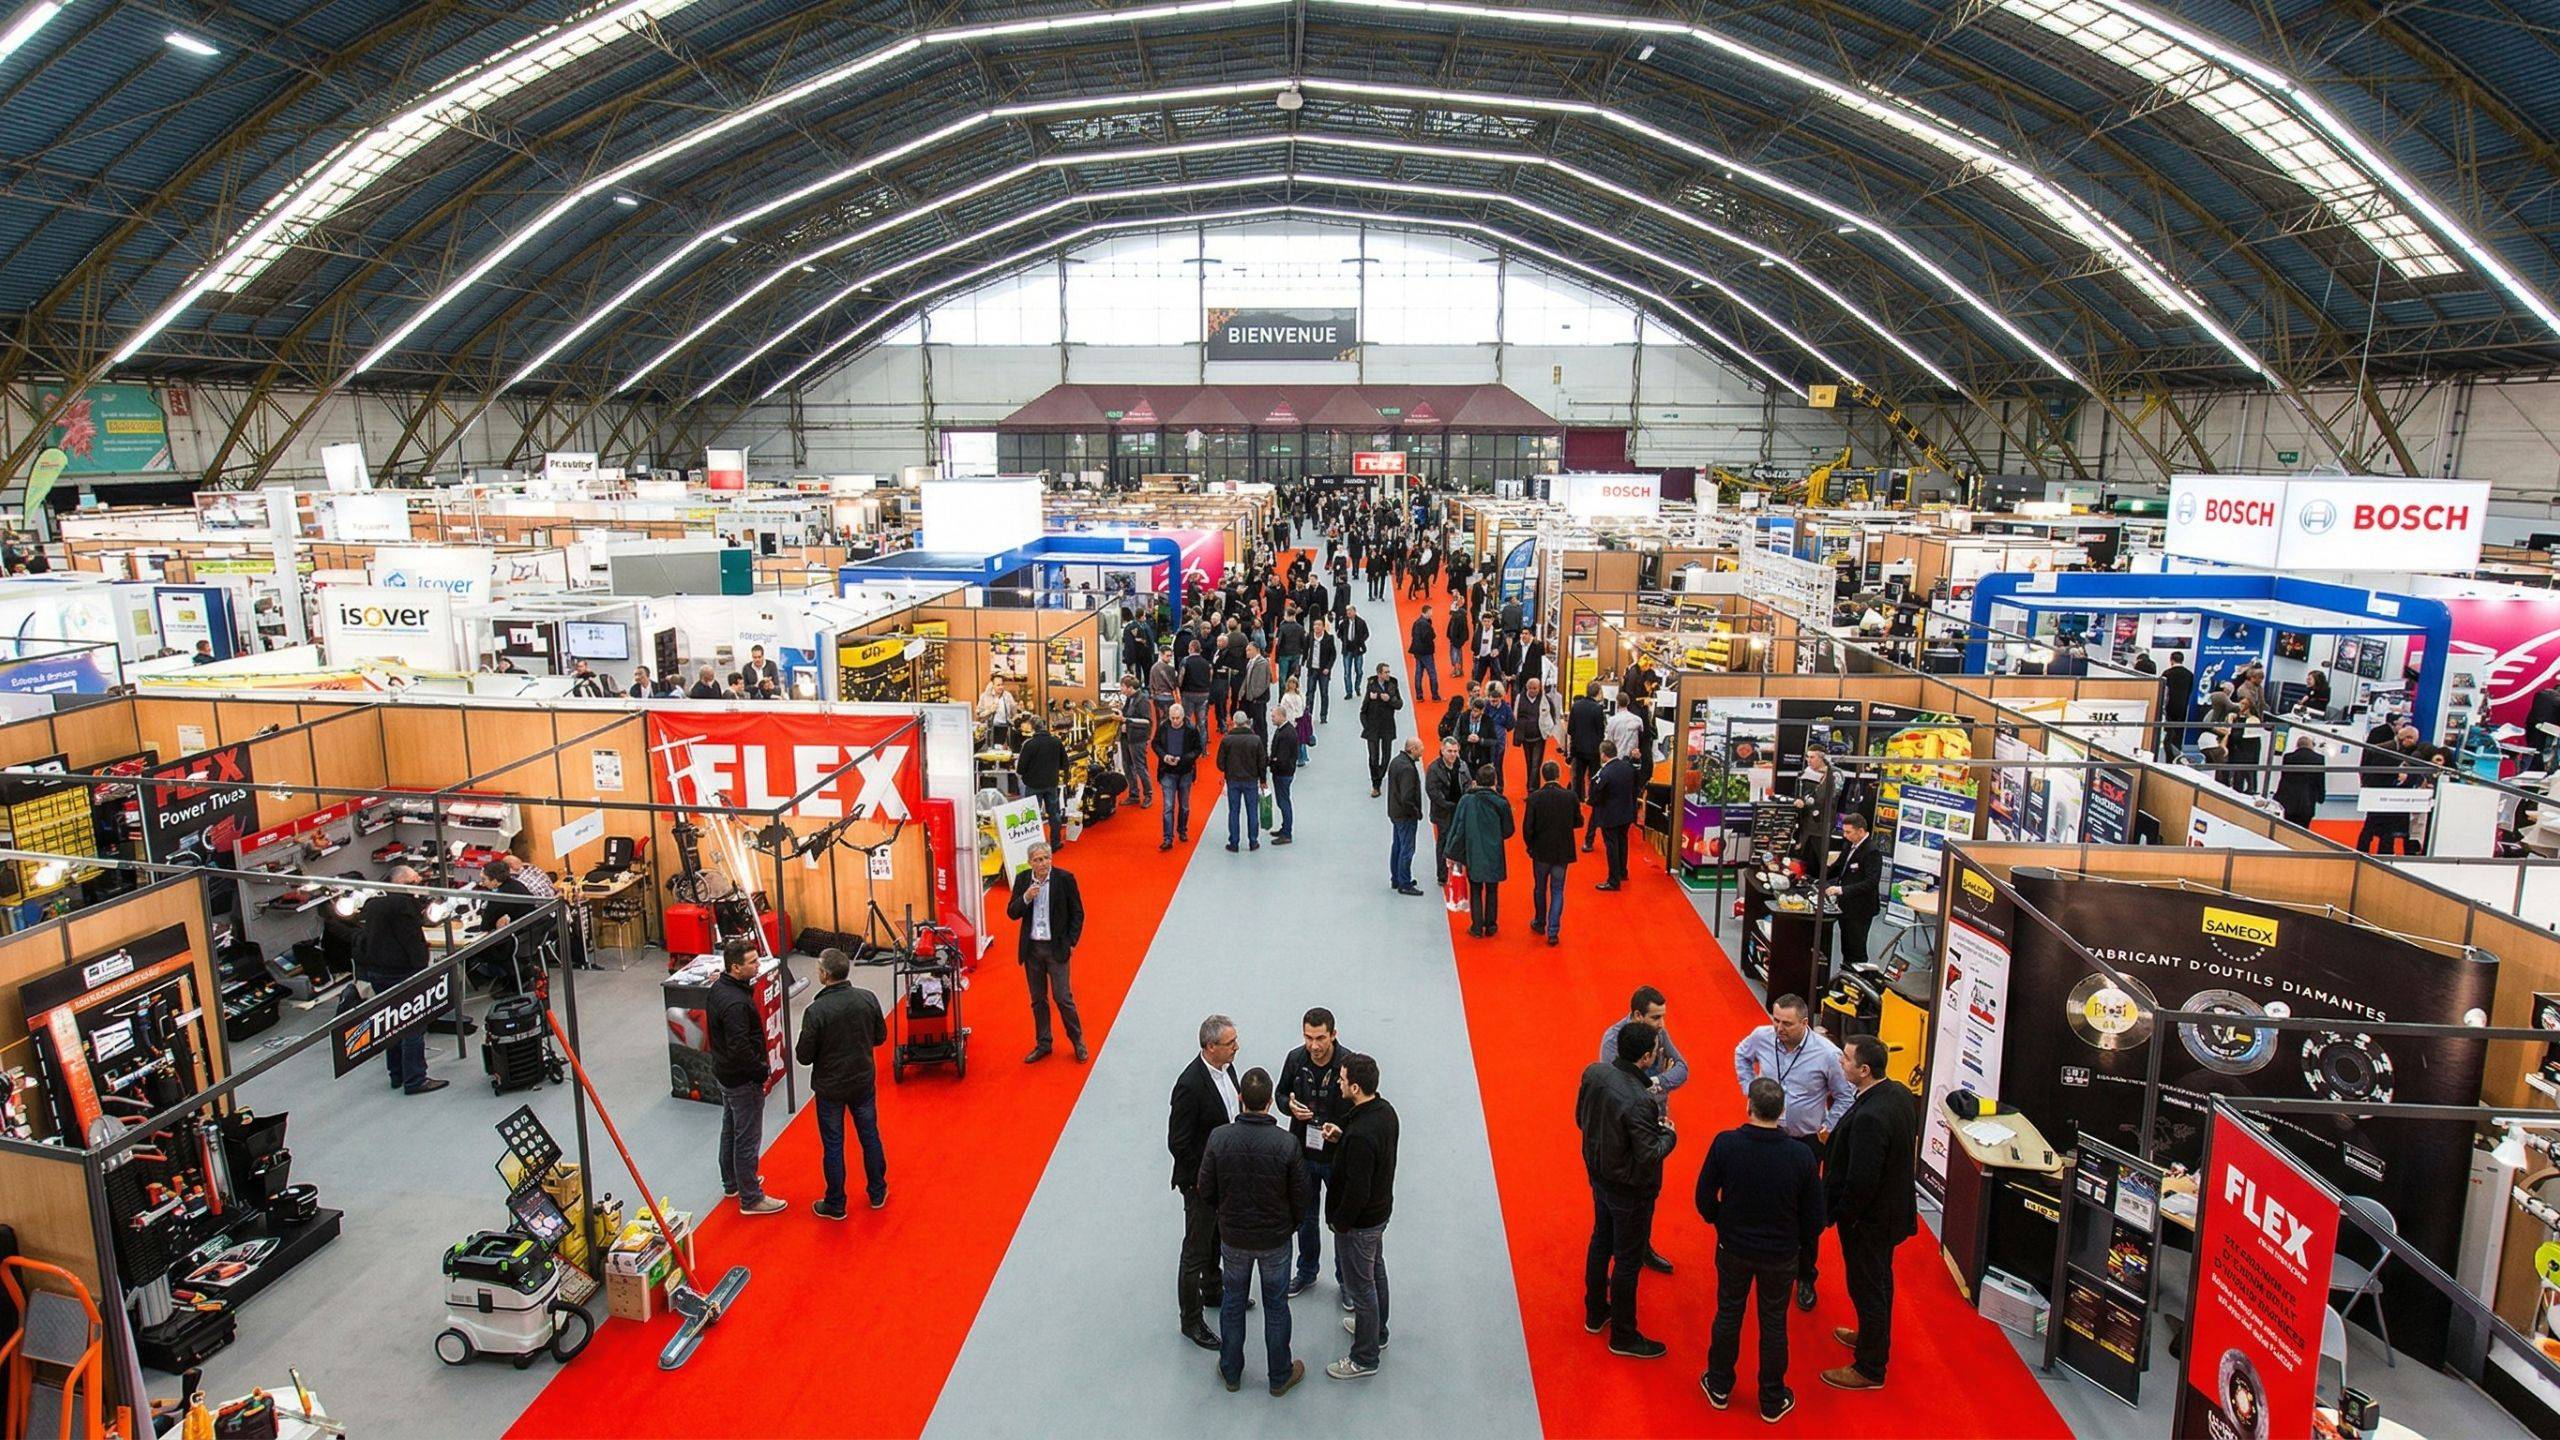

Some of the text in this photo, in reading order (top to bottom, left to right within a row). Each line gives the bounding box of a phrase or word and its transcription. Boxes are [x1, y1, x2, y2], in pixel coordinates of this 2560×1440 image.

[1228, 327, 1337, 344] BIENVENUE
[1603, 486, 1650, 498] BOSCH
[2205, 498, 2275, 527] BOSCH
[2353, 504, 2469, 531] BOSCH
[339, 603, 430, 627] isover
[153, 747, 245, 808] FLEX
[690, 743, 912, 820] FLEX
[159, 801, 207, 829] Power
[2086, 947, 2182, 968] FABRICANT
[2282, 980, 2387, 1023] DIAMANTES
[2224, 1163, 2313, 1271] FLEX
